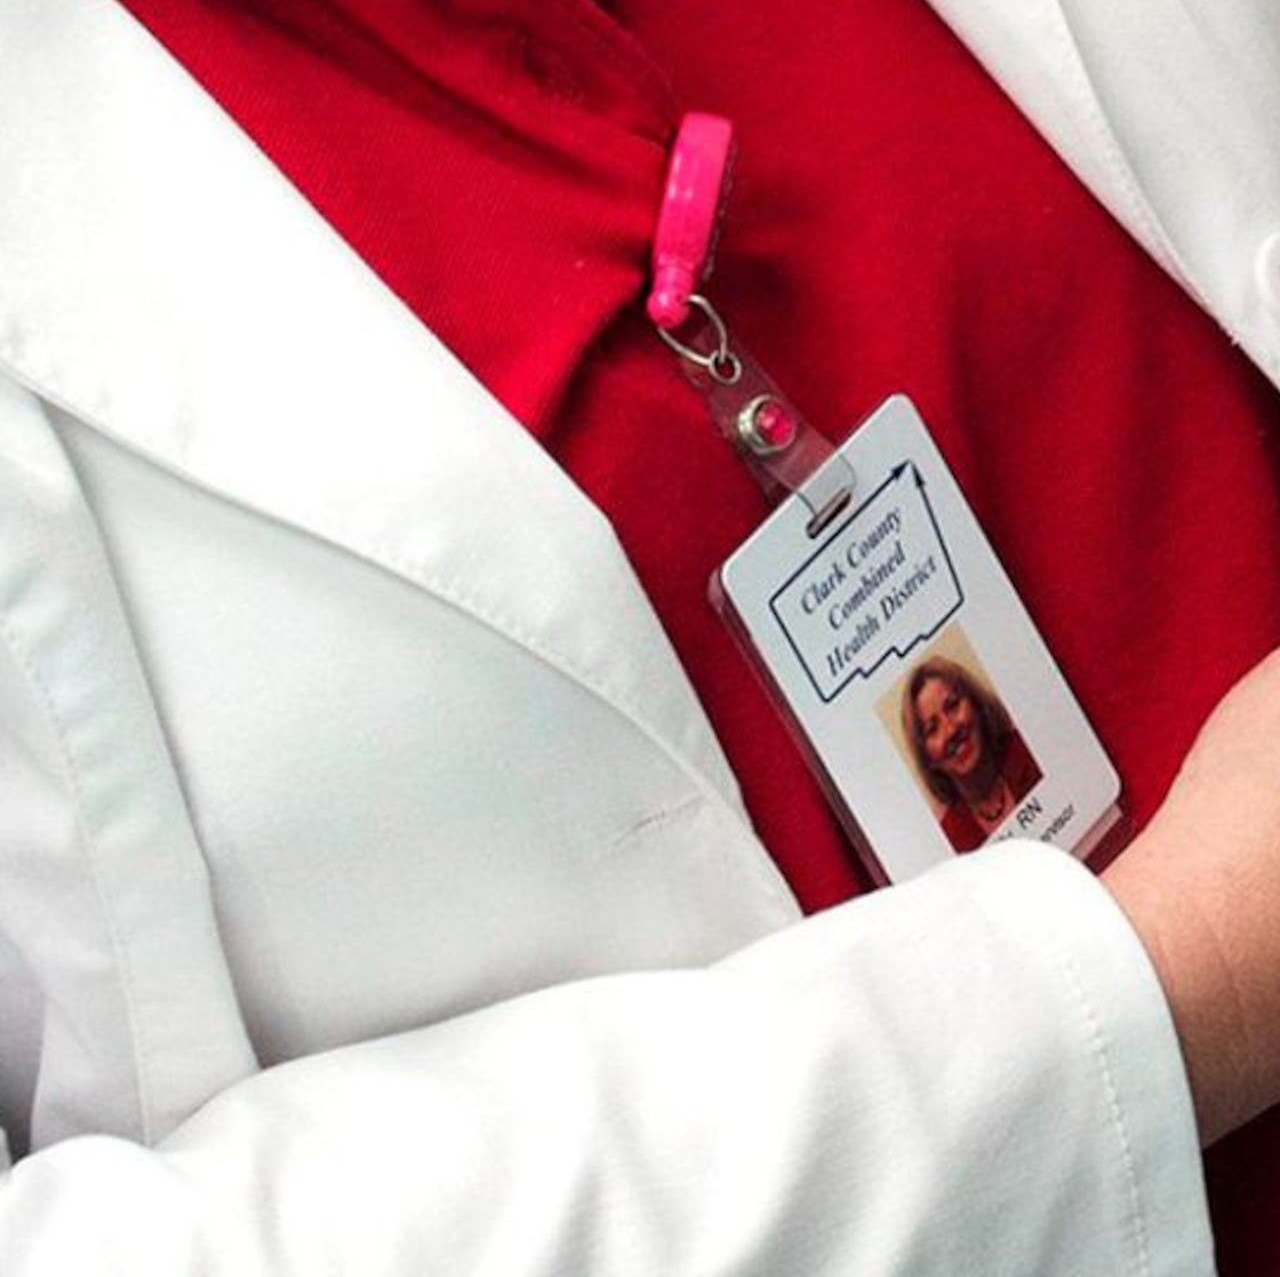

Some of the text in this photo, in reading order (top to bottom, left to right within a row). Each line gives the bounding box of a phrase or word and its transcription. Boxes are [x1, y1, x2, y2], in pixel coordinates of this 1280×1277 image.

[801, 508, 902, 614] Clark County
[829, 540, 906, 630] Combined
[827, 556, 937, 676] Health District
[1017, 798, 1044, 826] RN
